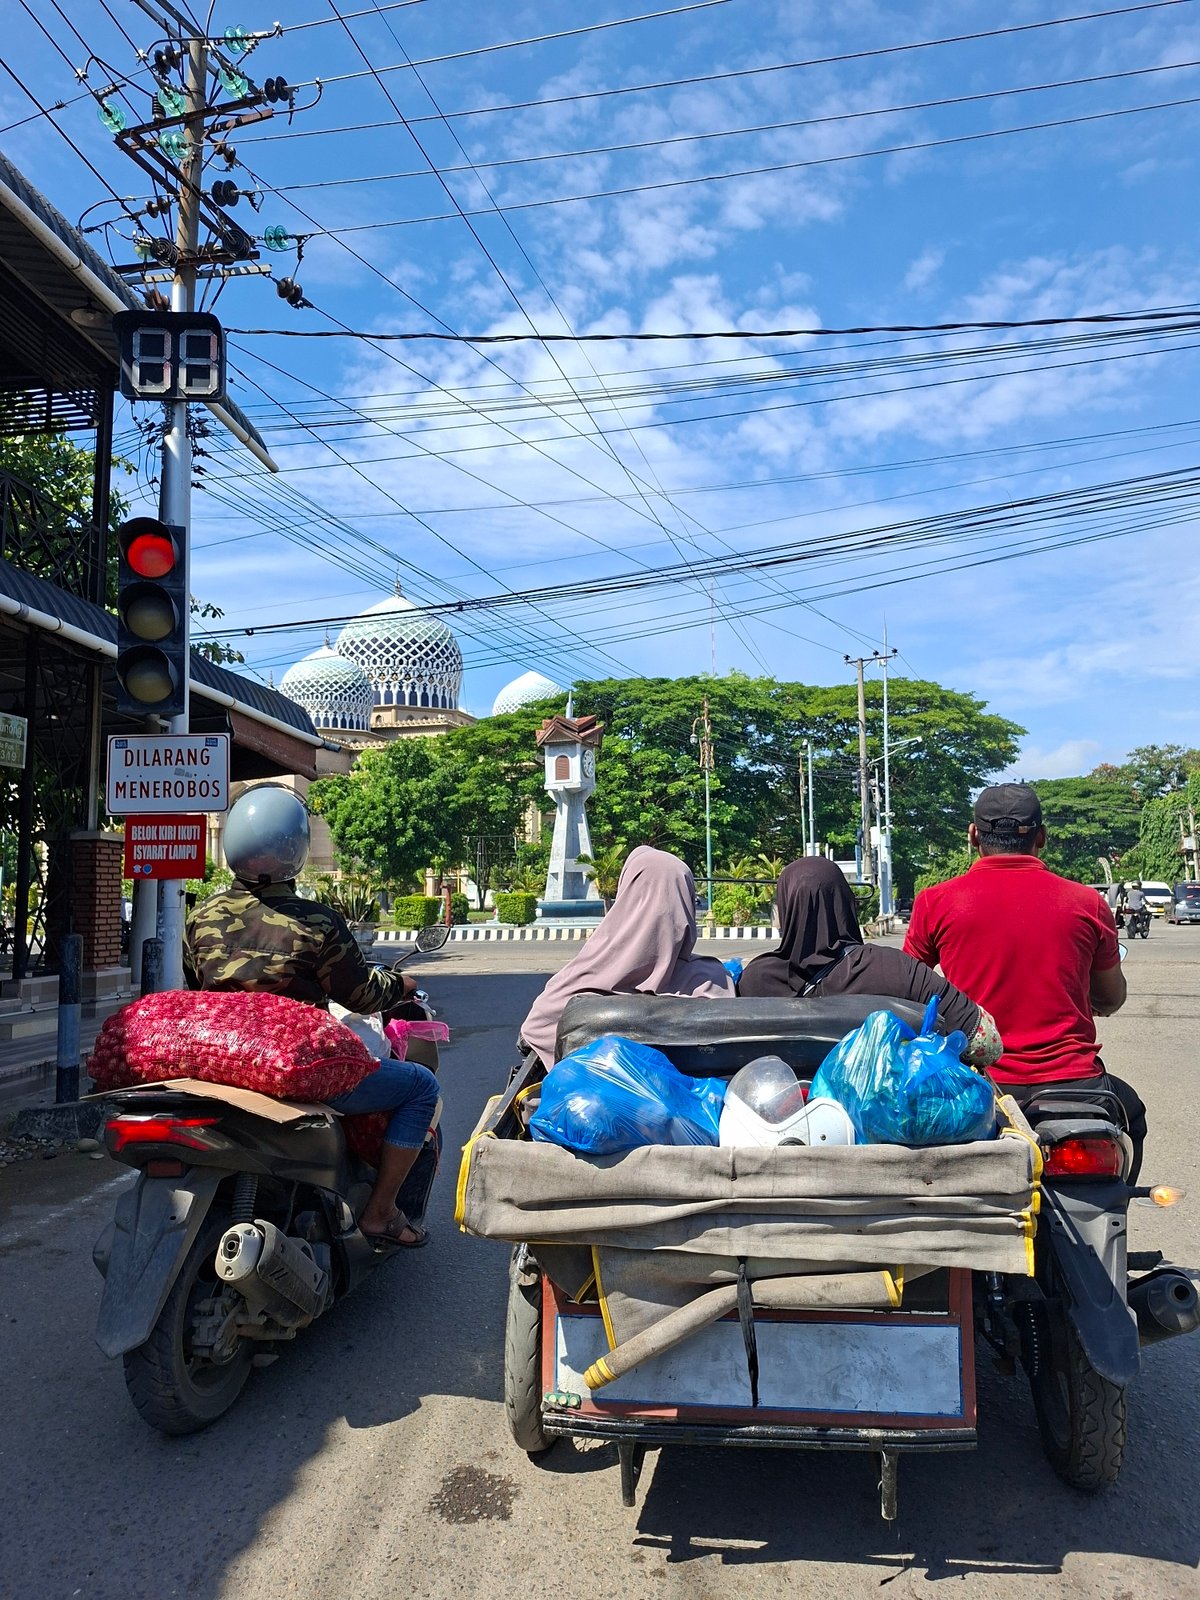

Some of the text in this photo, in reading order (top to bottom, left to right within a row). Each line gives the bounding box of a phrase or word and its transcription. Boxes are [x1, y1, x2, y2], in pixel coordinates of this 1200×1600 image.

[124, 747, 211, 767] DILARANG
[115, 780, 220, 799] MENEROBOS
[131, 825, 200, 841] BELOK KIRI IKUTI
[133, 844, 198, 860] ISYARAT LAMPU
